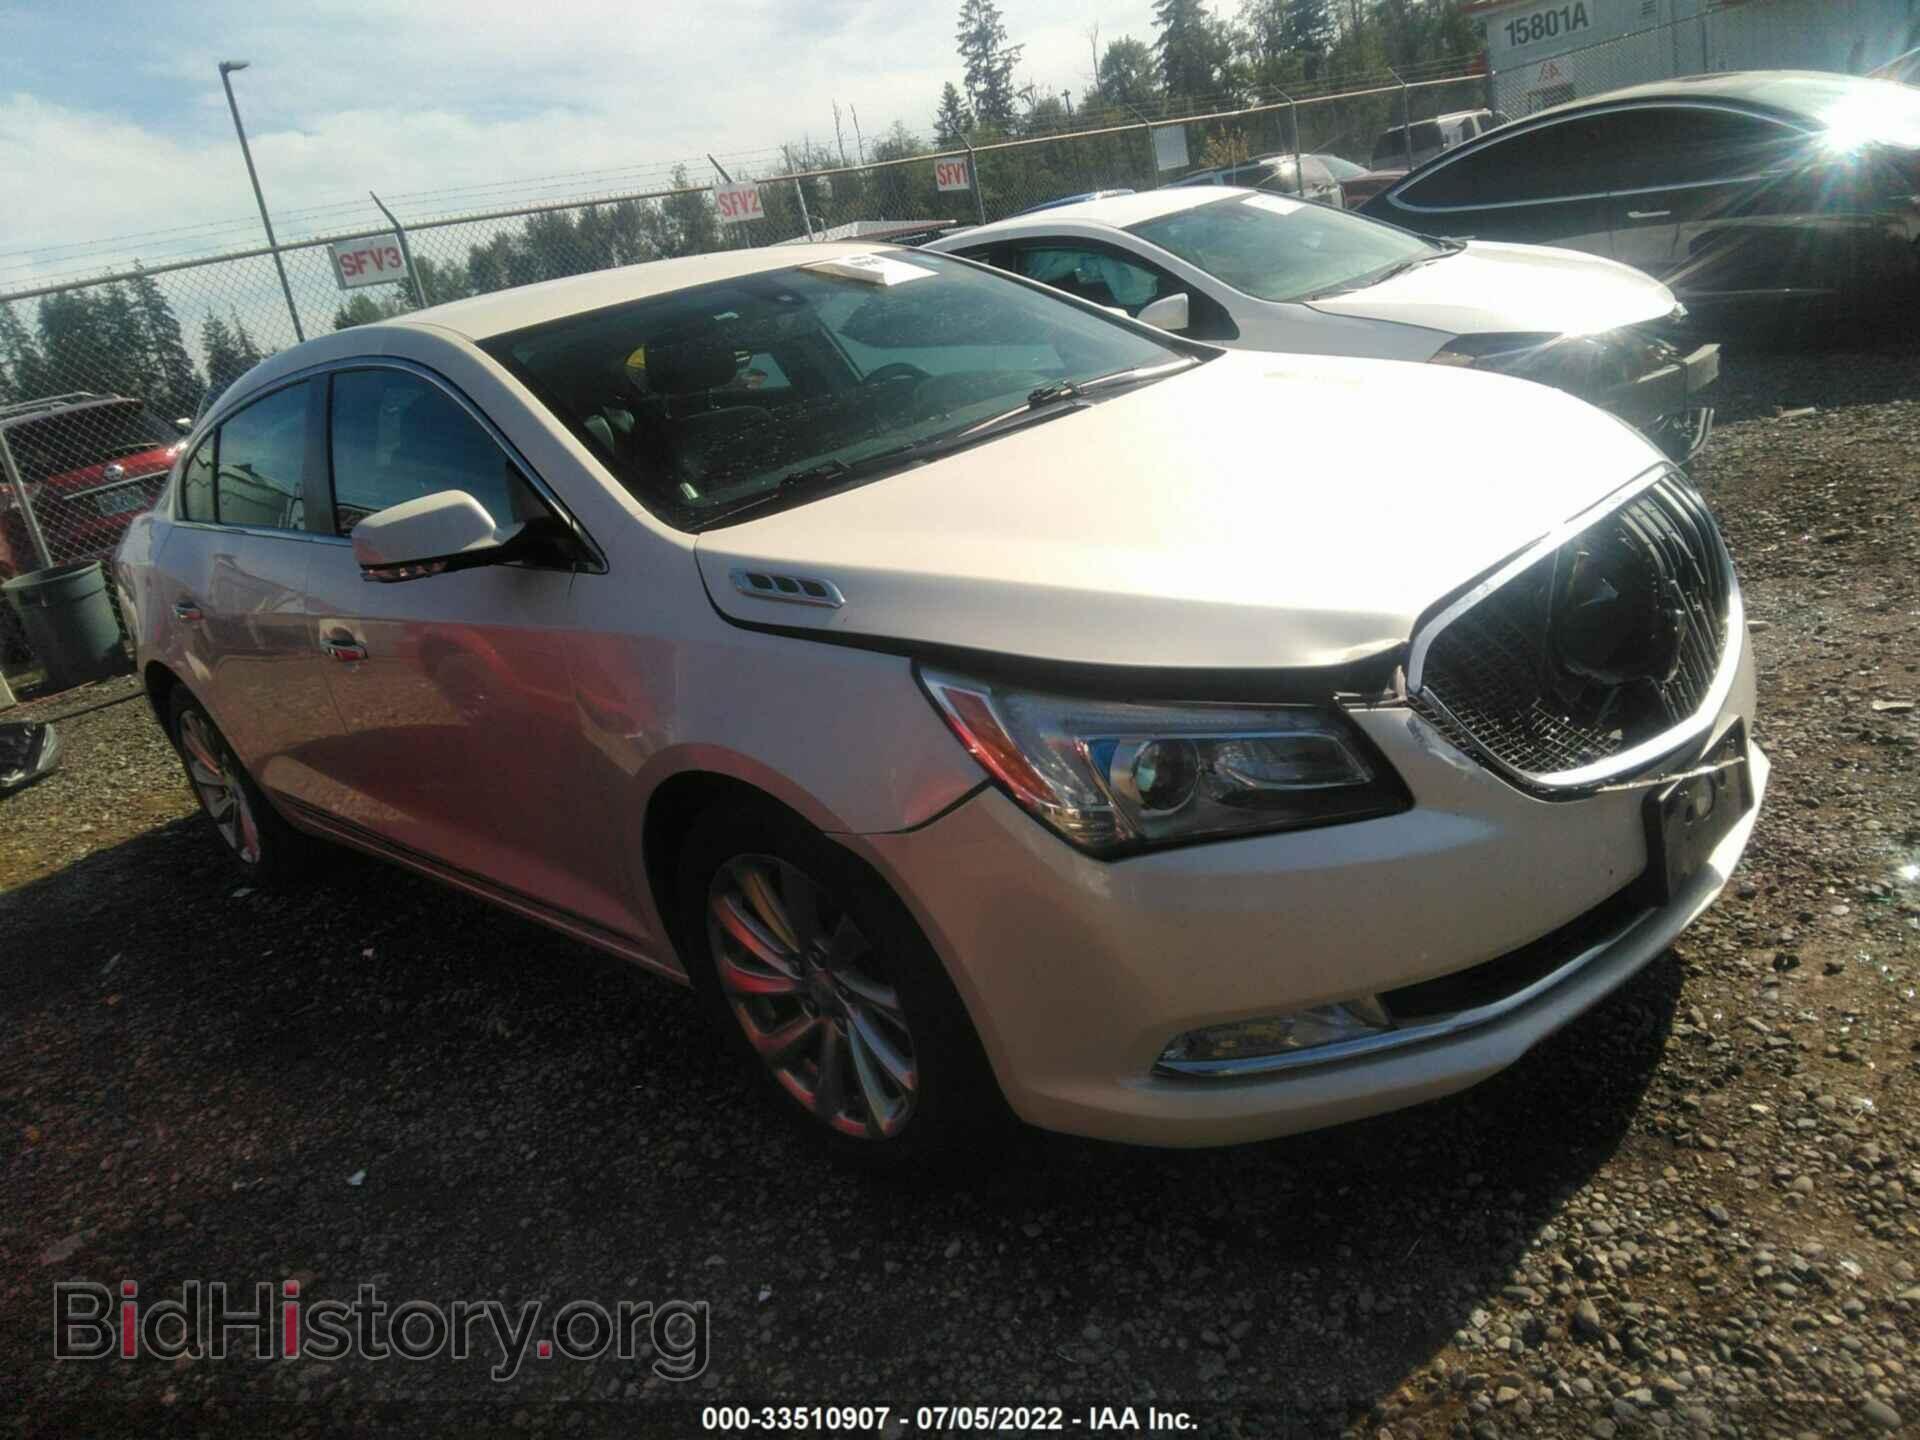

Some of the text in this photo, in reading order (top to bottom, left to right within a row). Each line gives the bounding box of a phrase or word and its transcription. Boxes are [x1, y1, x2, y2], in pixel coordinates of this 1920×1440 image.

[1504, 1, 1589, 47] 15801A
[937, 163, 968, 186] SFV1
[718, 191, 762, 216] SFV2
[339, 247, 402, 277] SFV3
